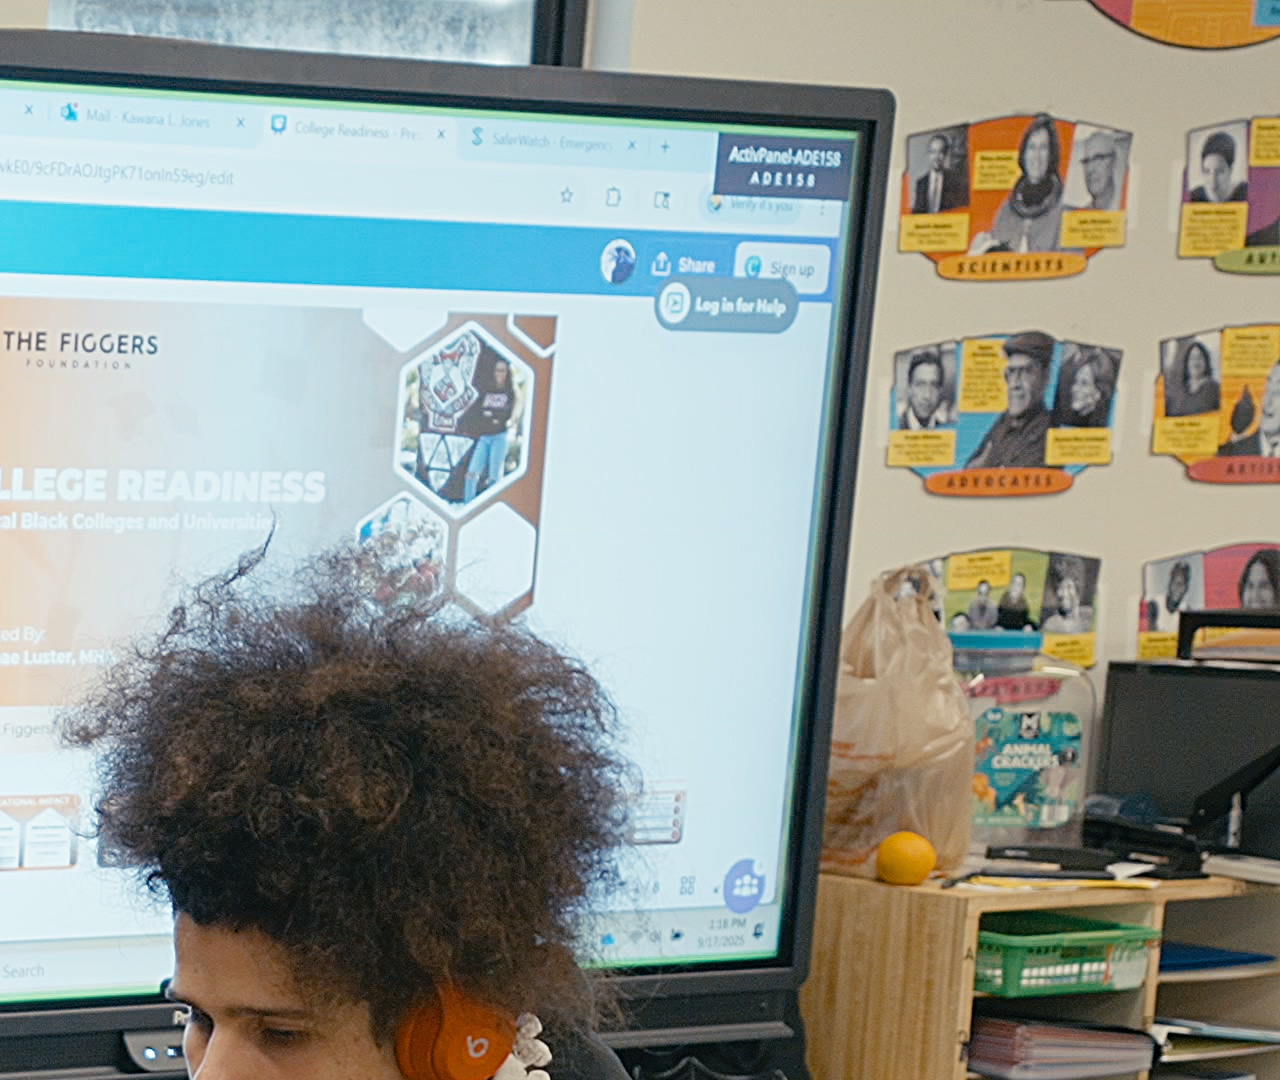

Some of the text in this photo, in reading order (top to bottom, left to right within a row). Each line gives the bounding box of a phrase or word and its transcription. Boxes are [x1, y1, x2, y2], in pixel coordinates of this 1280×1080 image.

[86, 108, 111, 123] Mail
[180, 114, 210, 129] Jones
[294, 122, 335, 138] College
[728, 145, 842, 168] ActivPanel-ADE158
[678, 257, 716, 273] Share
[770, 261, 815, 280] Sign up
[956, 258, 1064, 274] SCIENTISTS
[695, 296, 787, 318] Log in for Help
[3, 330, 159, 355] THE FIGGERS
[26, 359, 132, 370] FOUNDATION
[117, 468, 327, 503] READINESS
[946, 475, 1053, 488] ADVOCATES
[20, 511, 68, 530] Black
[72, 511, 145, 534] Colleges
[148, 512, 178, 530] and
[1001, 743, 1053, 756] ANIMAL
[991, 754, 1061, 771] CRACKERS
[2, 962, 45, 979] Search
